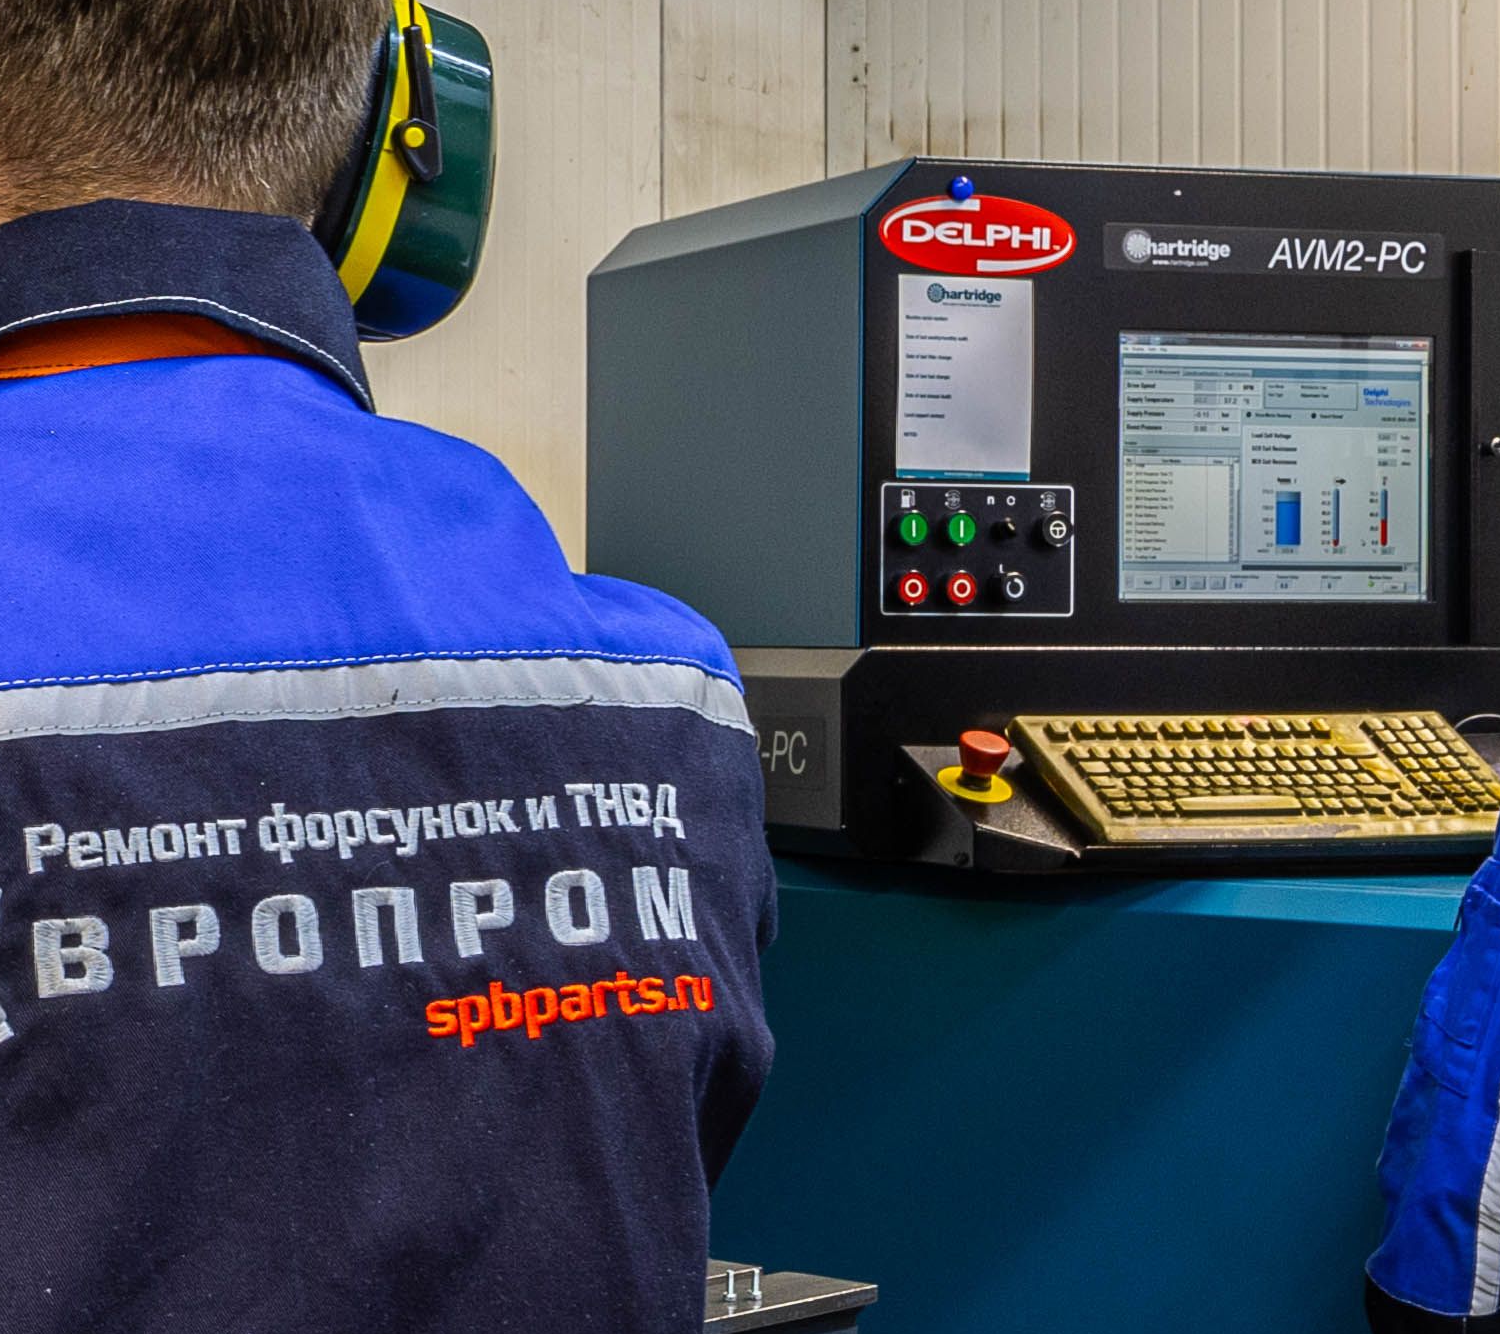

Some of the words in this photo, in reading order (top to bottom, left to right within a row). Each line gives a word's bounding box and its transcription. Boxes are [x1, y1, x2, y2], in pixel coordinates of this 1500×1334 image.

[902, 218, 1051, 251] DELPHI
[1146, 238, 1231, 261] hartridge
[1269, 237, 1427, 274] AVM2-PC
[941, 288, 1002, 304] hartridge
[22, 818, 250, 875] Ремонт
[258, 797, 520, 864] форсунок
[526, 793, 560, 830] и
[564, 782, 688, 840] ТНВД
[425, 971, 715, 1048] spbparts.ru
